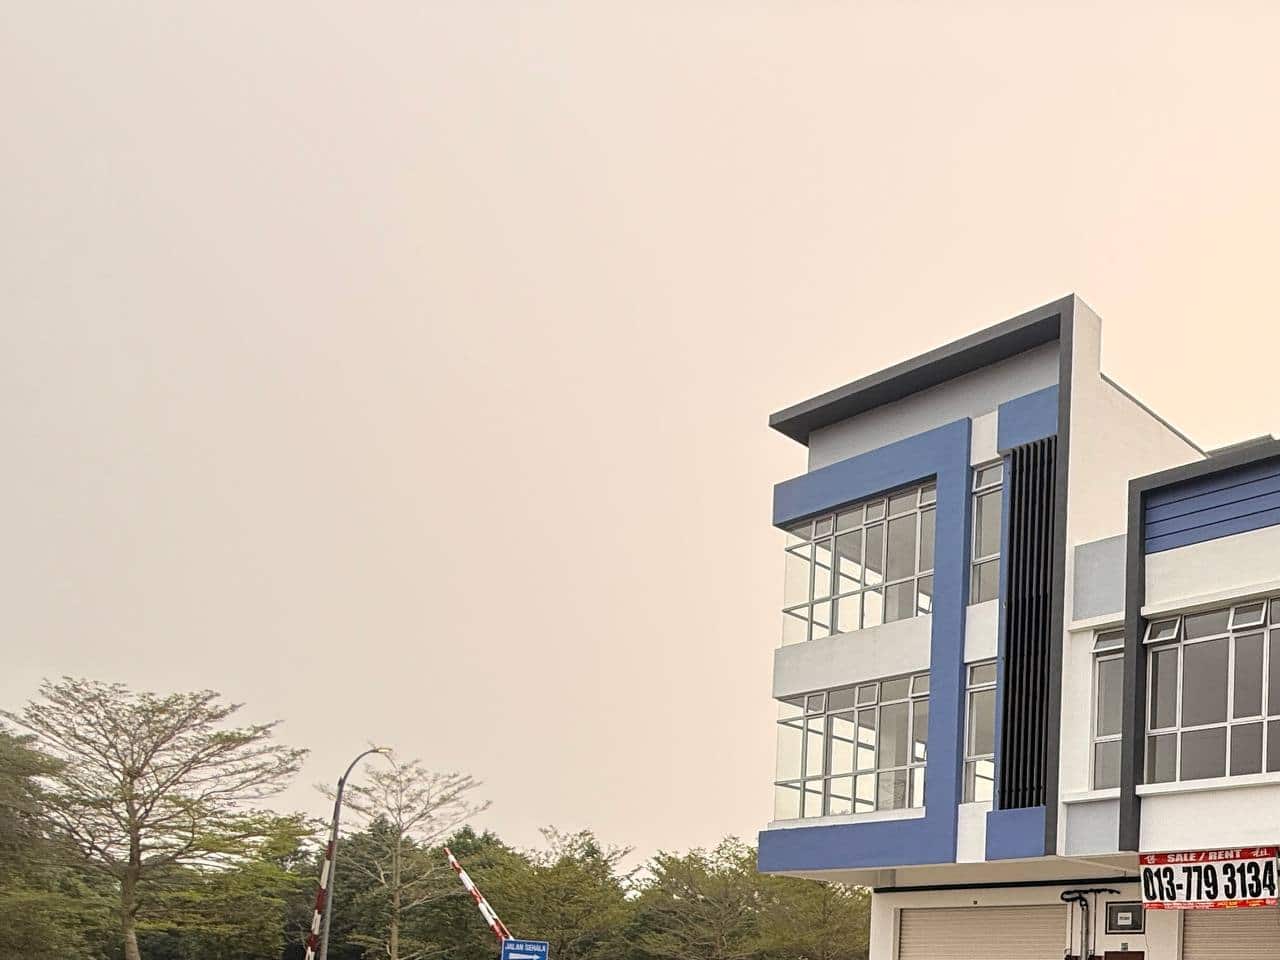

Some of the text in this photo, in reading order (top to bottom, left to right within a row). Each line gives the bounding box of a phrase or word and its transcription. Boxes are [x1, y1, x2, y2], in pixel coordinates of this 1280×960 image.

[1167, 853, 1196, 863] SALE
[1208, 849, 1242, 860] RENT
[1143, 860, 1276, 901] 013-779 3134
